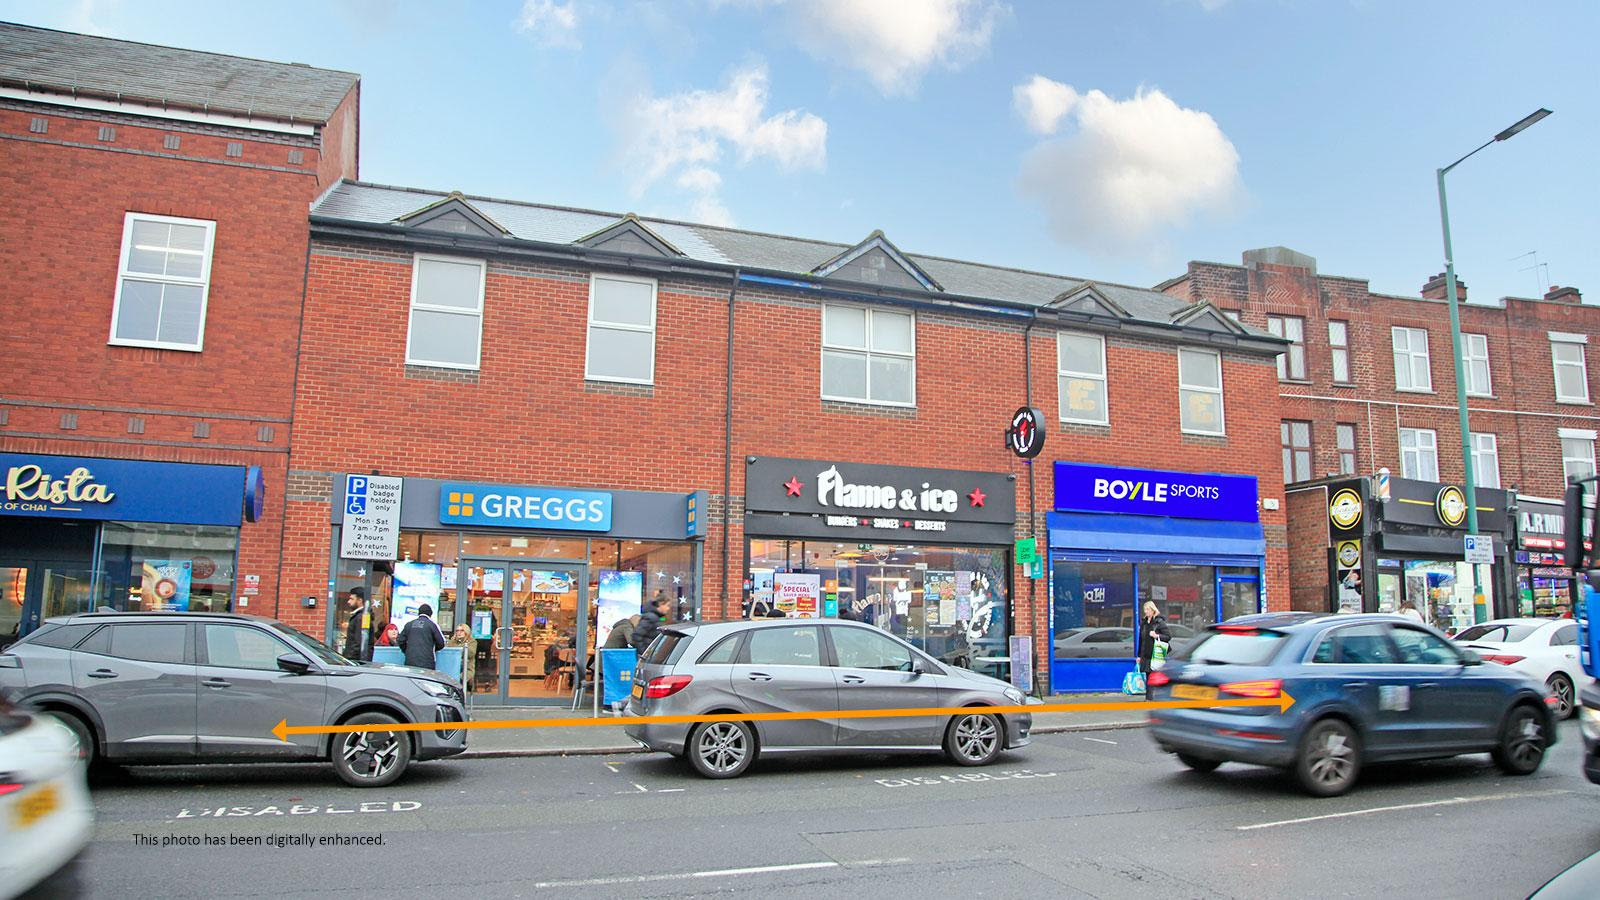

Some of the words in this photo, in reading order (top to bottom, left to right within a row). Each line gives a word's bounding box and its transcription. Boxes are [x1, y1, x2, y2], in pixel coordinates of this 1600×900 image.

[353, 479, 365, 493] P
[369, 482, 400, 491] Disabled
[816, 464, 897, 510] Flame
[898, 488, 917, 511] &
[920, 482, 958, 513] ice
[1093, 478, 1168, 503] BOYLE
[1170, 483, 1219, 500] SPORTS
[373, 490, 395, 498] badge
[4, 503, 20, 511] OF
[21, 503, 47, 512] CHAI
[481, 494, 604, 523] GREGGS
[873, 517, 899, 529] SHAKES
[914, 519, 946, 531] DESSERTS
[783, 585, 811, 593] SPECIAL
[175, 800, 423, 819] DISABLED
